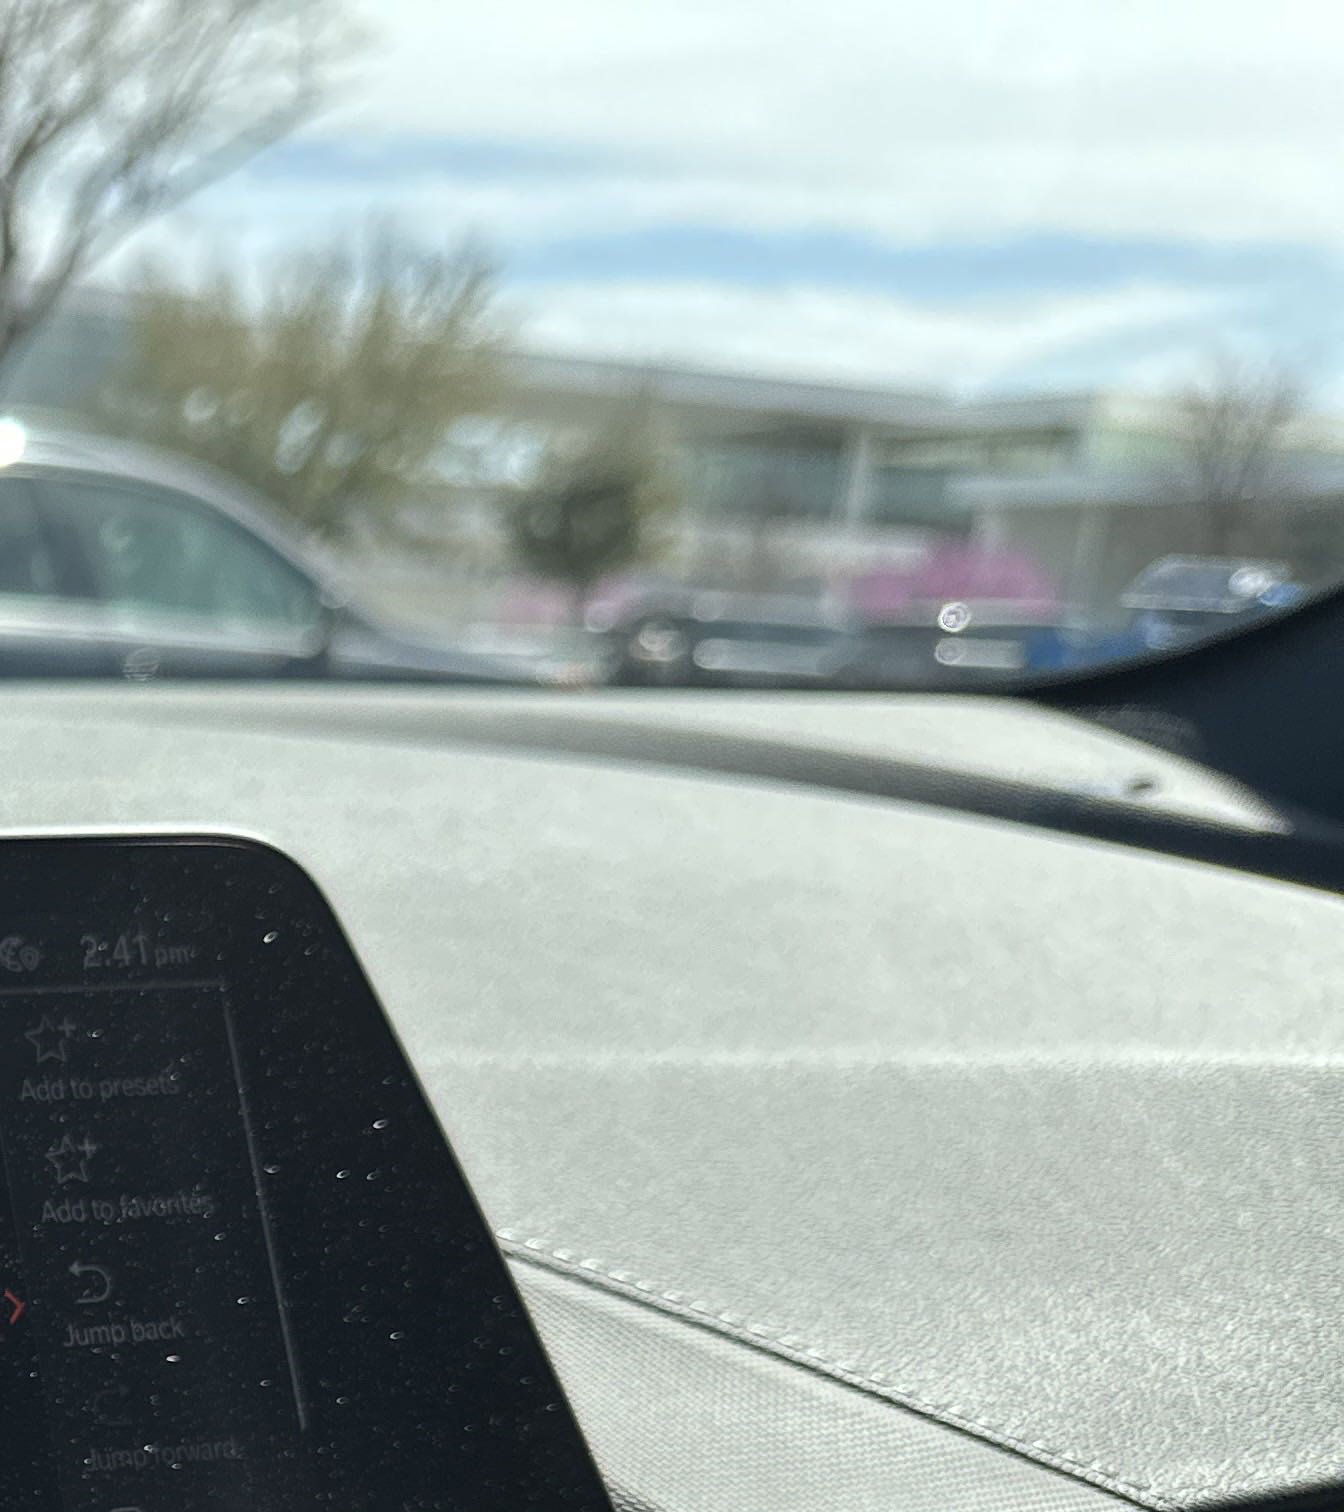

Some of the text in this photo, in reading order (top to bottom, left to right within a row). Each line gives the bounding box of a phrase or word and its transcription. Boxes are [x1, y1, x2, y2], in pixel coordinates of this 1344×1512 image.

[20, 1078, 64, 1101] Add
[70, 1077, 94, 1099] to
[42, 1199, 86, 1223] Add
[92, 1198, 114, 1220] to
[64, 1316, 185, 1347] Jump back
